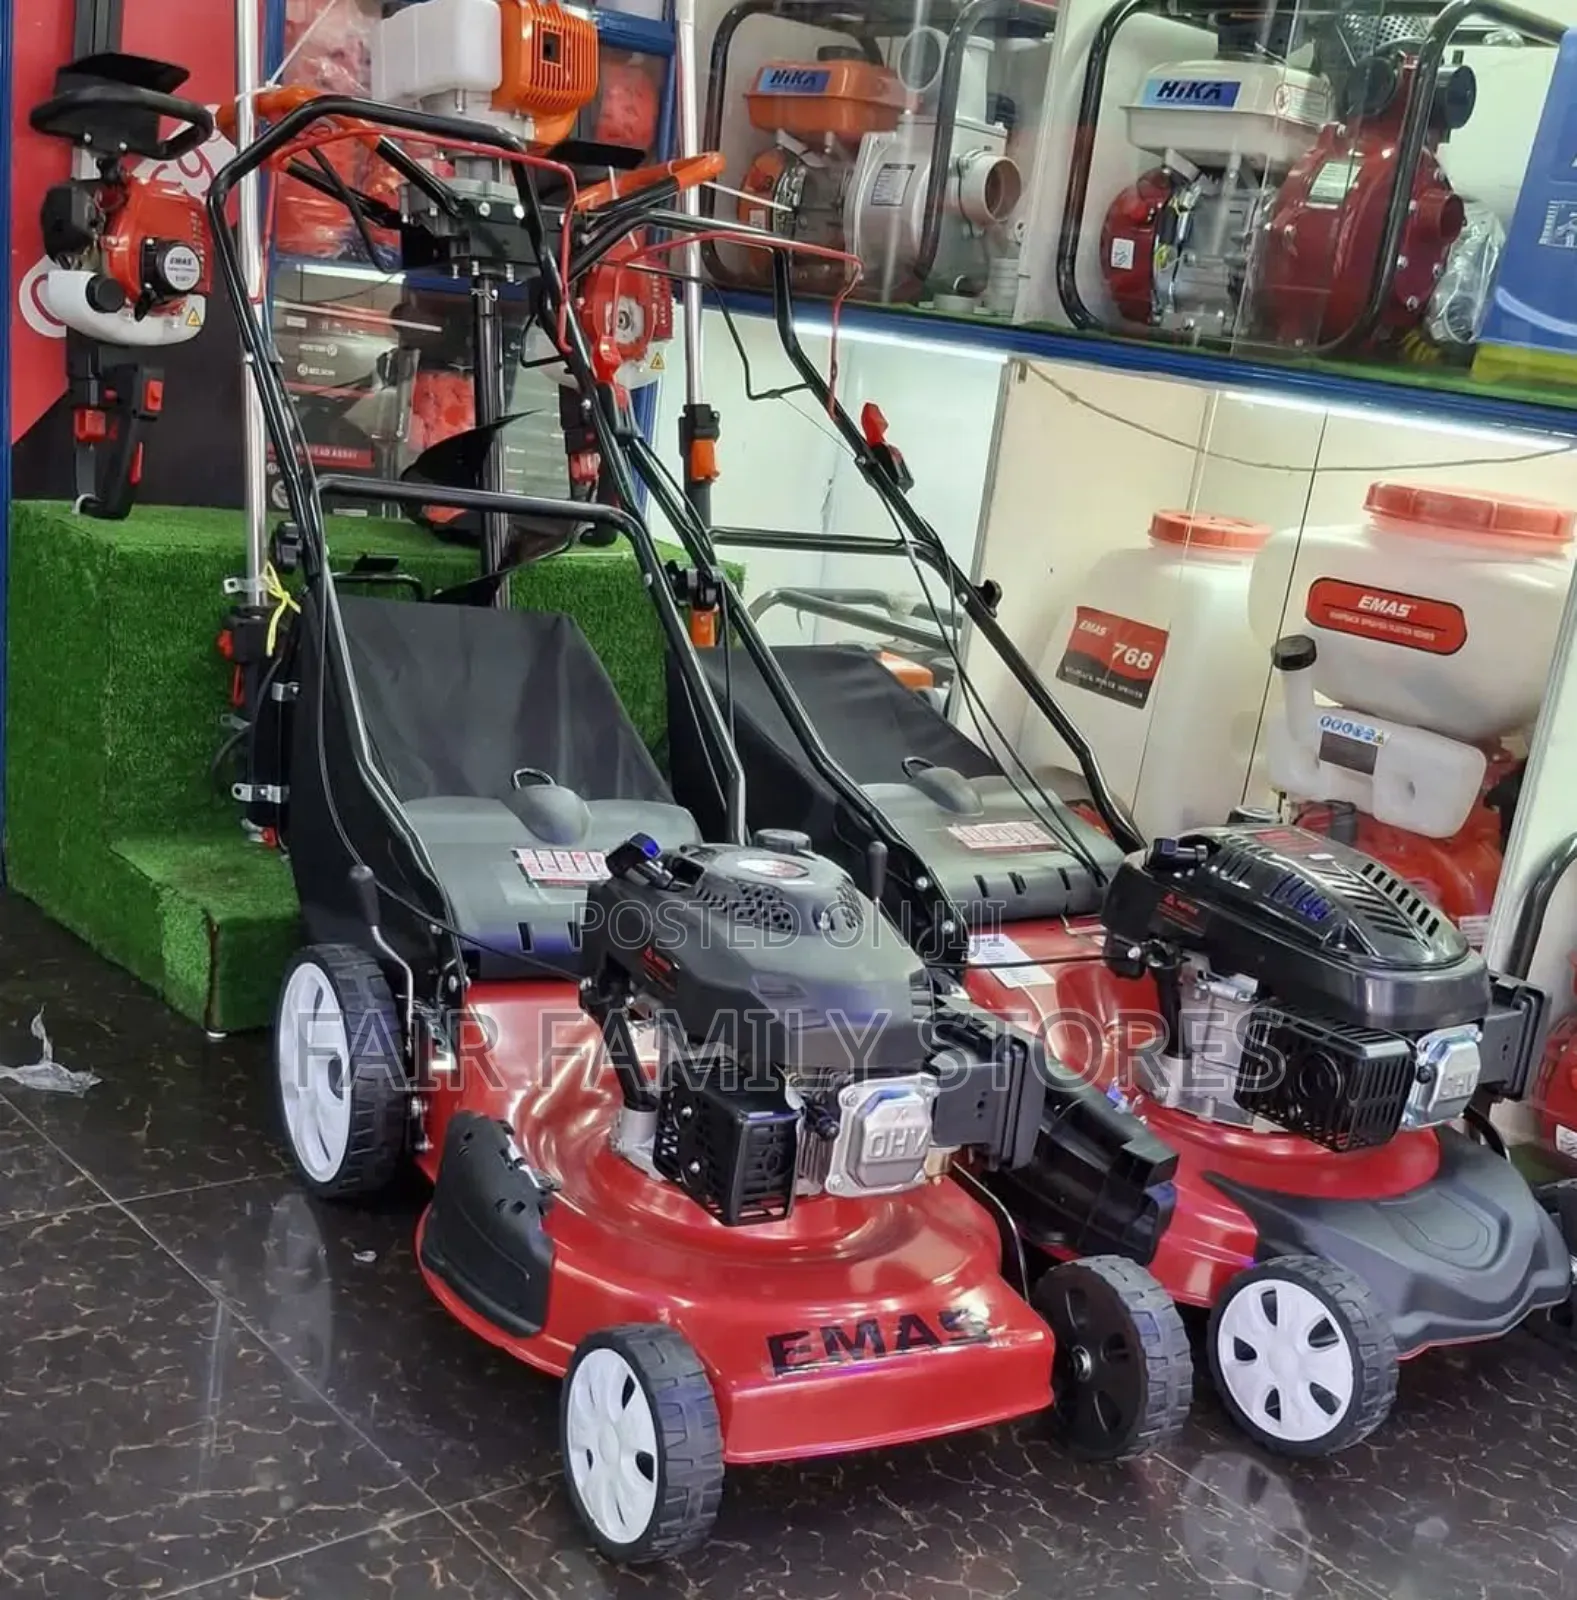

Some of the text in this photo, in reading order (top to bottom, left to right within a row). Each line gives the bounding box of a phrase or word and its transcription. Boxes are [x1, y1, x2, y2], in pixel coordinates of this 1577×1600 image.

[1357, 594, 1412, 618] EMAS
[1078, 619, 1108, 637] EMAS
[1112, 641, 1154, 670] 768
[869, 1127, 929, 1159] OHV
[765, 1308, 993, 1378] EMAS
